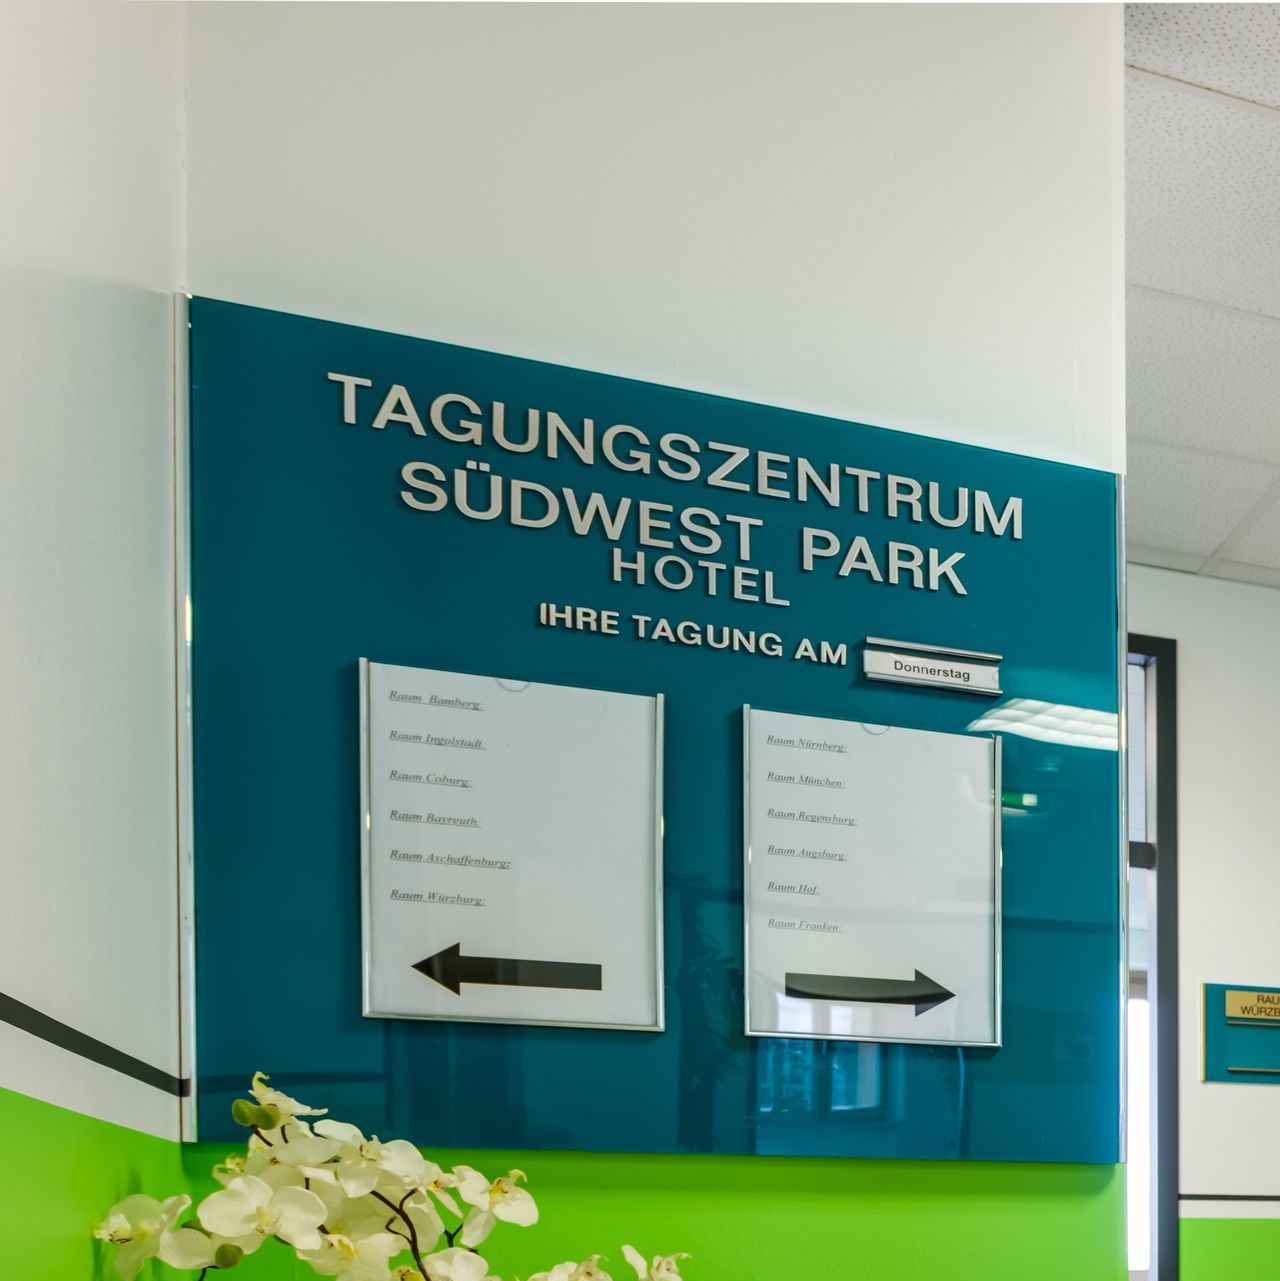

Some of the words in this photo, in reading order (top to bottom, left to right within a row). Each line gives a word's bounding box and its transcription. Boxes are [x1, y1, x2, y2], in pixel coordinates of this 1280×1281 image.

[327, 372, 1023, 540] TAGUNGSZENTRUM
[400, 460, 763, 562] SÜDWEST
[803, 526, 969, 596] PARK
[612, 547, 791, 607] HOTEL
[539, 602, 620, 635] IHRE
[631, 614, 784, 657] TAGUNG
[794, 638, 848, 666] AM
[893, 659, 971, 682] Donnerstag
[389, 690, 422, 703] Raum
[389, 730, 422, 743] Raum
[767, 735, 795, 747] Raum
[389, 769, 422, 783] Raum
[767, 771, 795, 784] Raum
[390, 809, 423, 822] Raum
[767, 808, 796, 820] Raum
[390, 849, 423, 862] Raum
[767, 845, 796, 857] Raum
[767, 881, 796, 894] Raum
[390, 889, 423, 902] Raum
[767, 918, 796, 930] Raum
